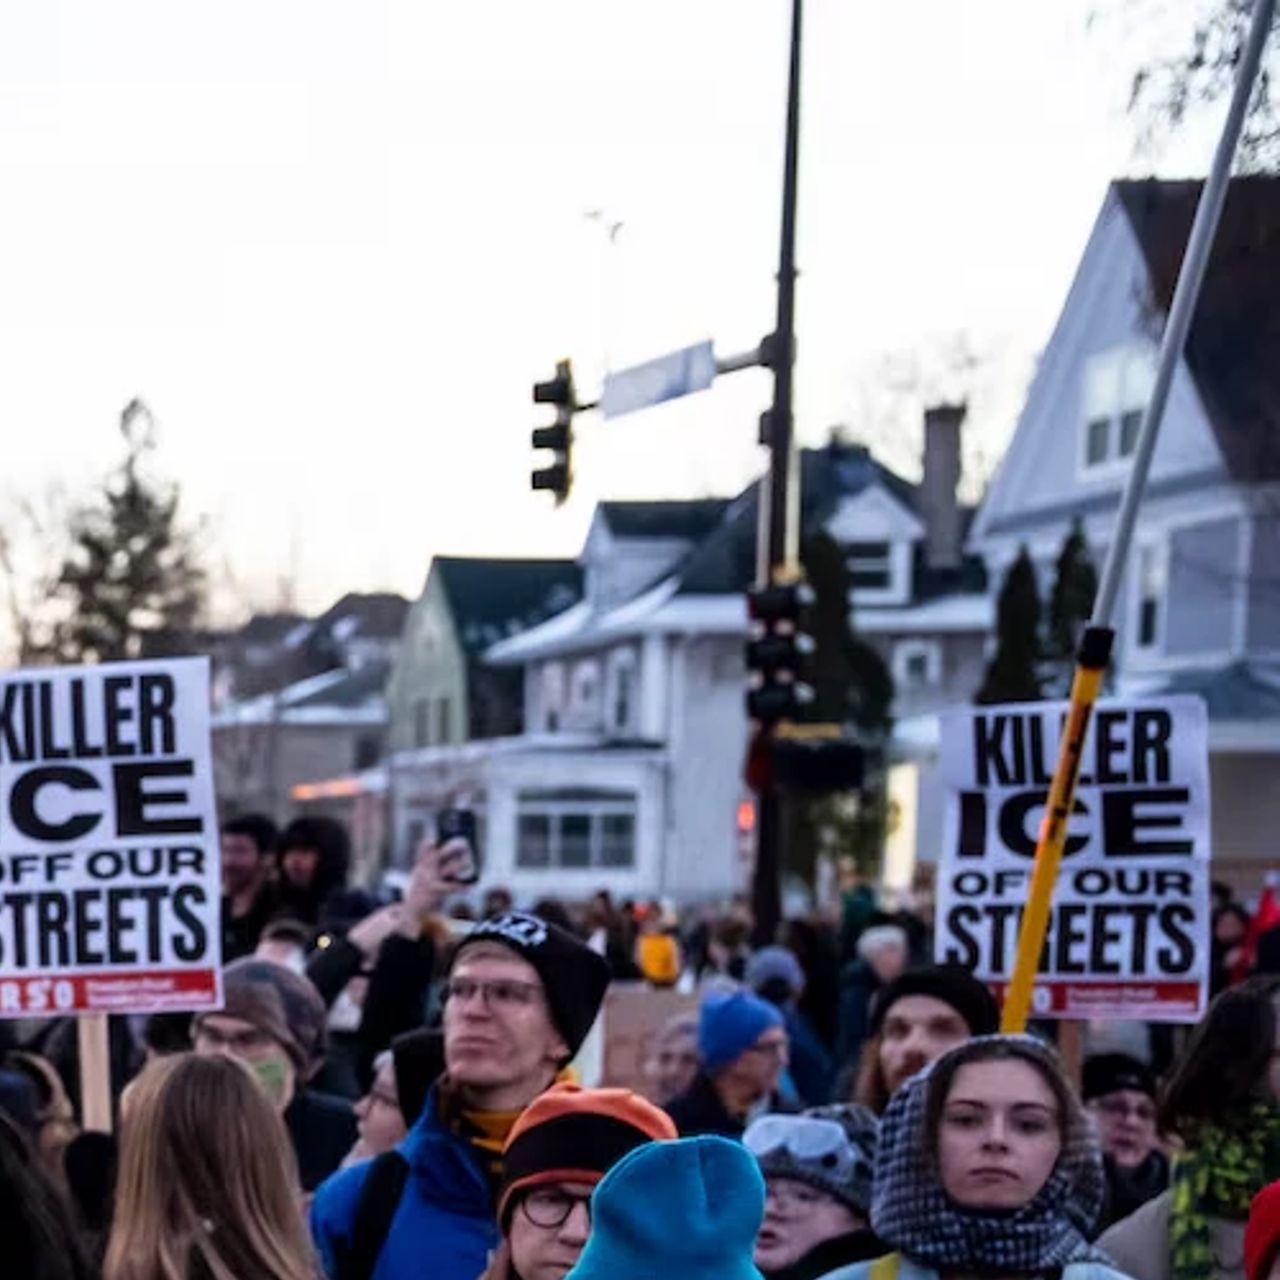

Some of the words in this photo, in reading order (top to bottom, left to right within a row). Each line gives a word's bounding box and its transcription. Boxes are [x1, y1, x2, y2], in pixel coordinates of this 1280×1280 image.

[957, 789, 1194, 859] ICE
[86, 847, 205, 880] OUR
[1074, 869, 1192, 896] OUR
